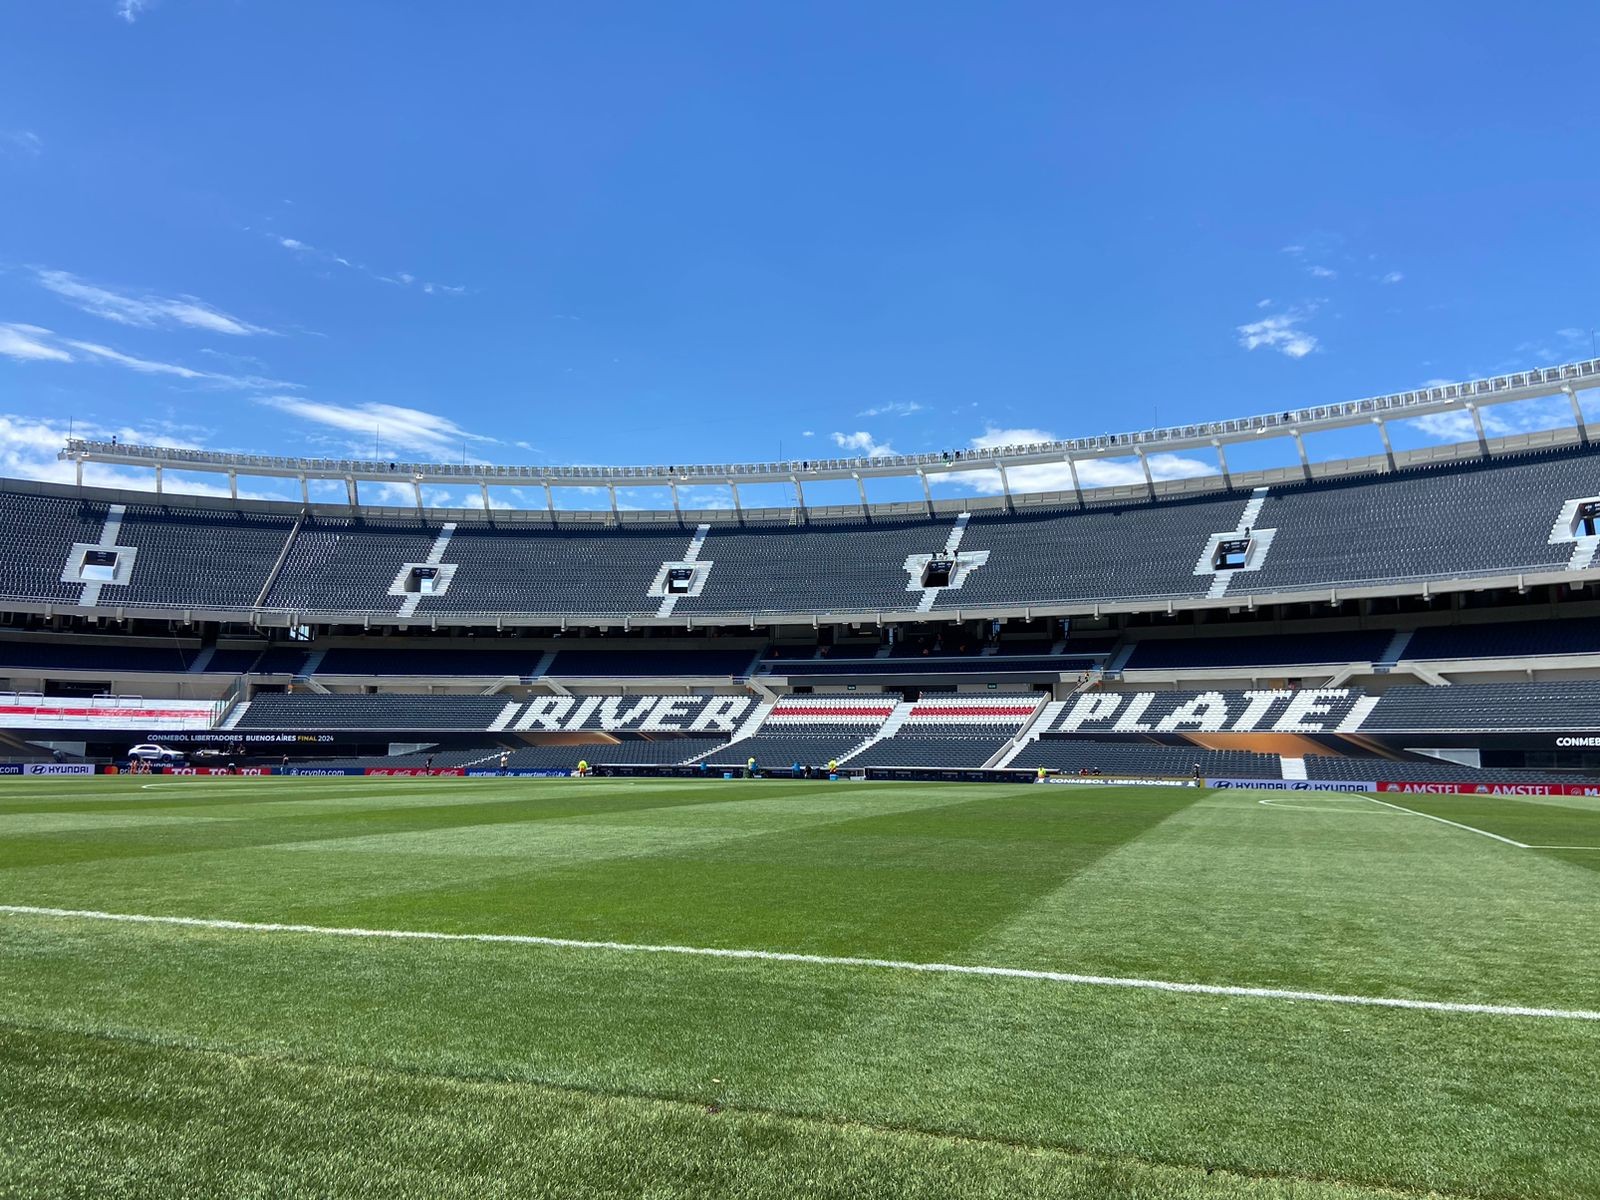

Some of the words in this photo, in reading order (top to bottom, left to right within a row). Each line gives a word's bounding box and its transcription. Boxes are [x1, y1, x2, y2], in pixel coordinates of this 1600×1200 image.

[513, 696, 751, 732] RIVER
[1059, 689, 1349, 733] PLATE
[147, 734, 189, 742] CONMEBOL
[190, 734, 243, 742] LIBERTADORES
[246, 734, 274, 742] BUENOS
[300, 768, 345, 776] crypto.com
[1107, 779, 1183, 787] LIBERTADORES
[1235, 782, 1287, 790] HYUNDAI
[1314, 784, 1368, 792] HYUNDAI
